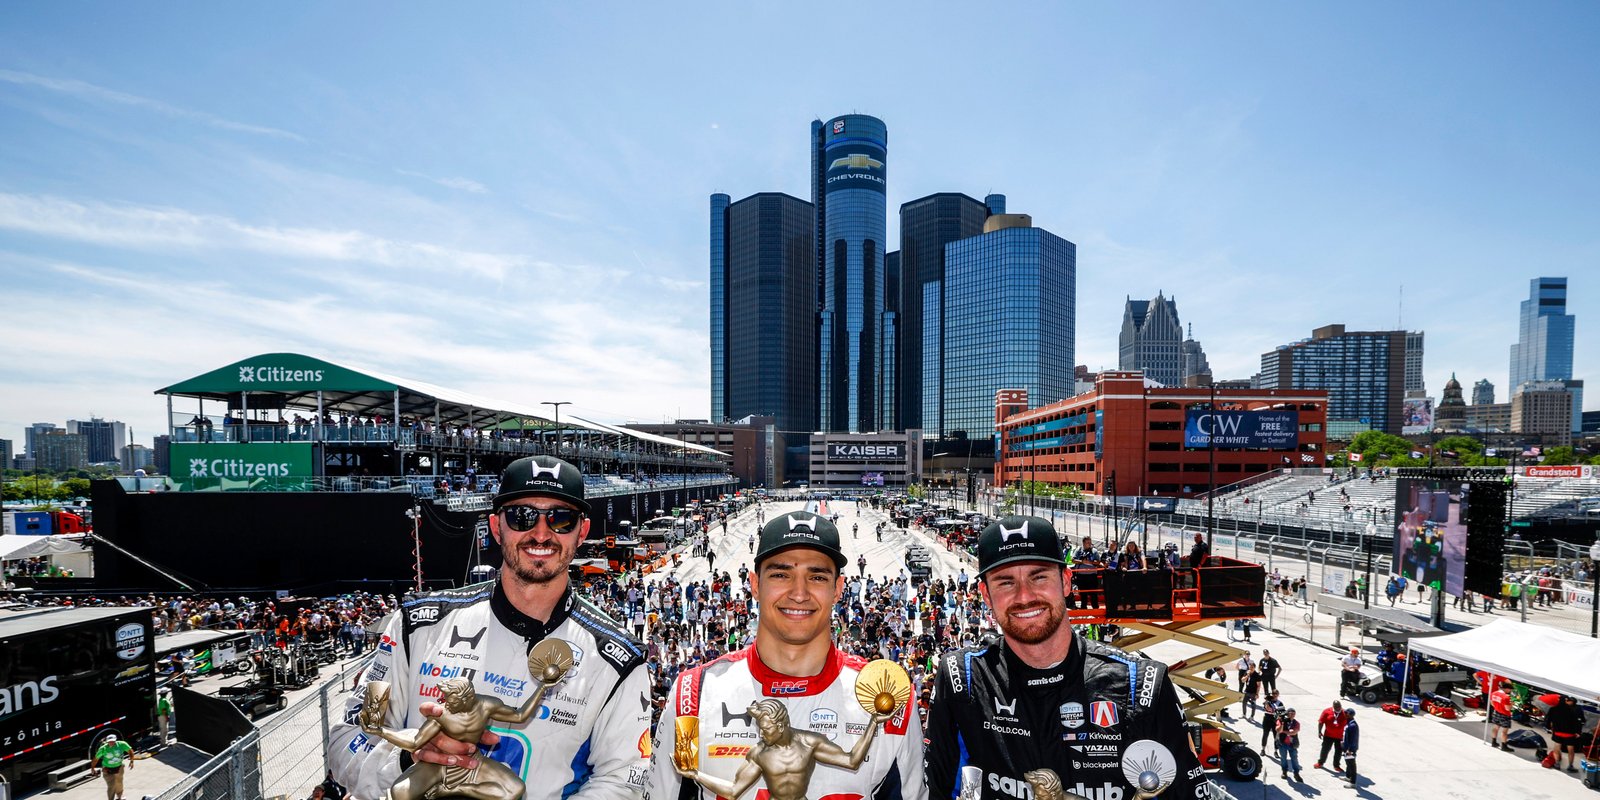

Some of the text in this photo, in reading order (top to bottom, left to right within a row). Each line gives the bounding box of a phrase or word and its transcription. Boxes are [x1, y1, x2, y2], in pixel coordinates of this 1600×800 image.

[827, 173, 885, 185] CHEVROLET
[256, 366, 323, 382] Citizens
[1196, 414, 1243, 435] GW
[1261, 422, 1281, 431] FREE
[1225, 436, 1249, 444] WHITE
[835, 445, 898, 456] KAISER
[211, 459, 289, 477] Citizens
[1529, 467, 1578, 477] Grandstand
[525, 479, 564, 489] Honda
[604, 535, 616, 549] 5
[782, 531, 821, 541] Honda
[998, 541, 1035, 552] Honda
[409, 608, 440, 622] OMP
[127, 628, 142, 637] NTT
[116, 636, 145, 648] INDYCAR
[438, 650, 480, 661] Honda
[604, 642, 630, 663] OMP
[419, 662, 460, 679] Mobil
[946, 655, 963, 694] sparco
[1048, 674, 1064, 683] club
[493, 686, 523, 698] GROUP
[771, 681, 809, 694] HRC
[1139, 665, 1157, 707] sparco
[555, 690, 588, 707] Edwards
[680, 674, 693, 715] sparco
[552, 707, 578, 720] United
[820, 713, 835, 721] NTT
[992, 715, 1019, 723] Honda
[550, 716, 577, 727] Rentals
[809, 722, 838, 730] INDYCAR
[714, 731, 757, 739] Honda
[991, 724, 1031, 737] GOLD.COM
[1077, 731, 1122, 741] 27 Kirkwood
[1082, 761, 1119, 769] blackpoint
[1066, 782, 1123, 800] lub
